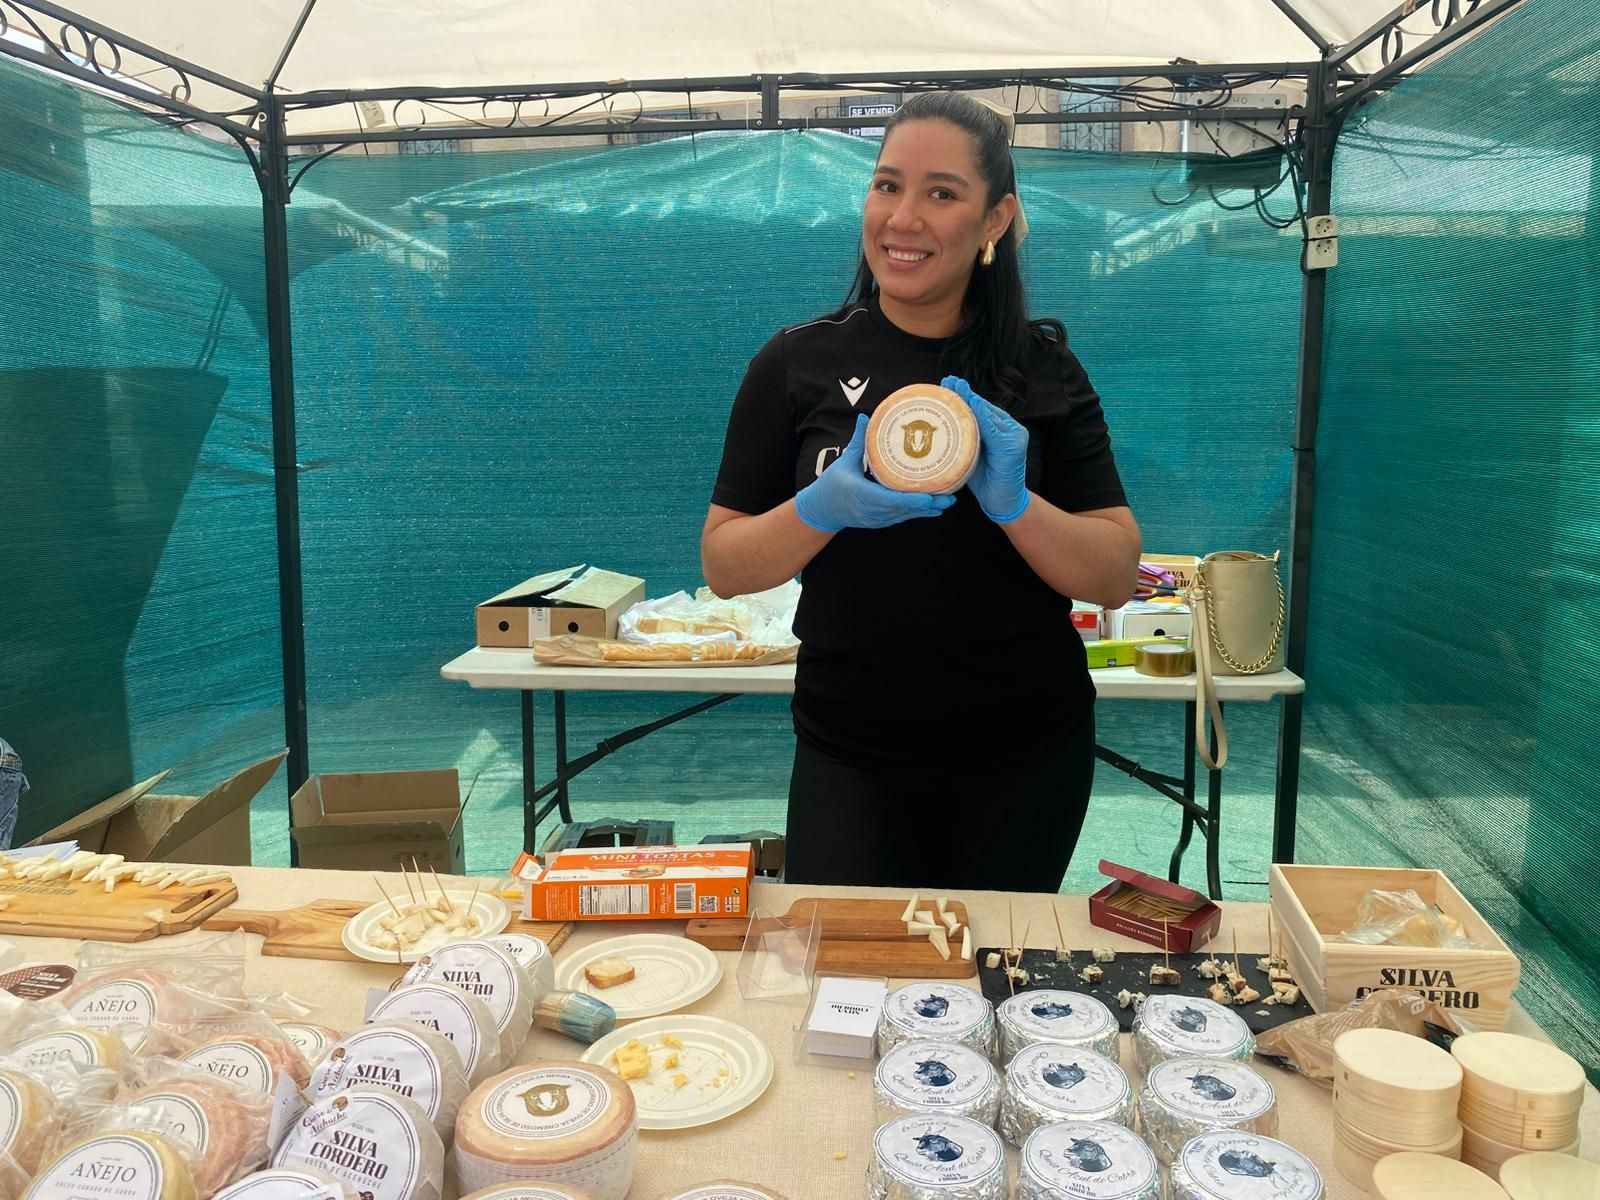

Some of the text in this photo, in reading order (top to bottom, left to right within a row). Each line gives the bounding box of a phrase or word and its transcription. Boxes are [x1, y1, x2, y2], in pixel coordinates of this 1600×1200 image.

[852, 108, 862, 117] SE
[590, 852, 715, 861] MINI TOSTAS
[442, 971, 481, 982] SILVA
[1380, 968, 1456, 988] SILVA
[83, 999, 137, 1014] AÑEJO
[355, 1064, 401, 1082] SILVA
[330, 1130, 377, 1158] SILVA
[310, 1142, 388, 1180] CORDERO
[70, 1160, 137, 1183] AÑEJO
